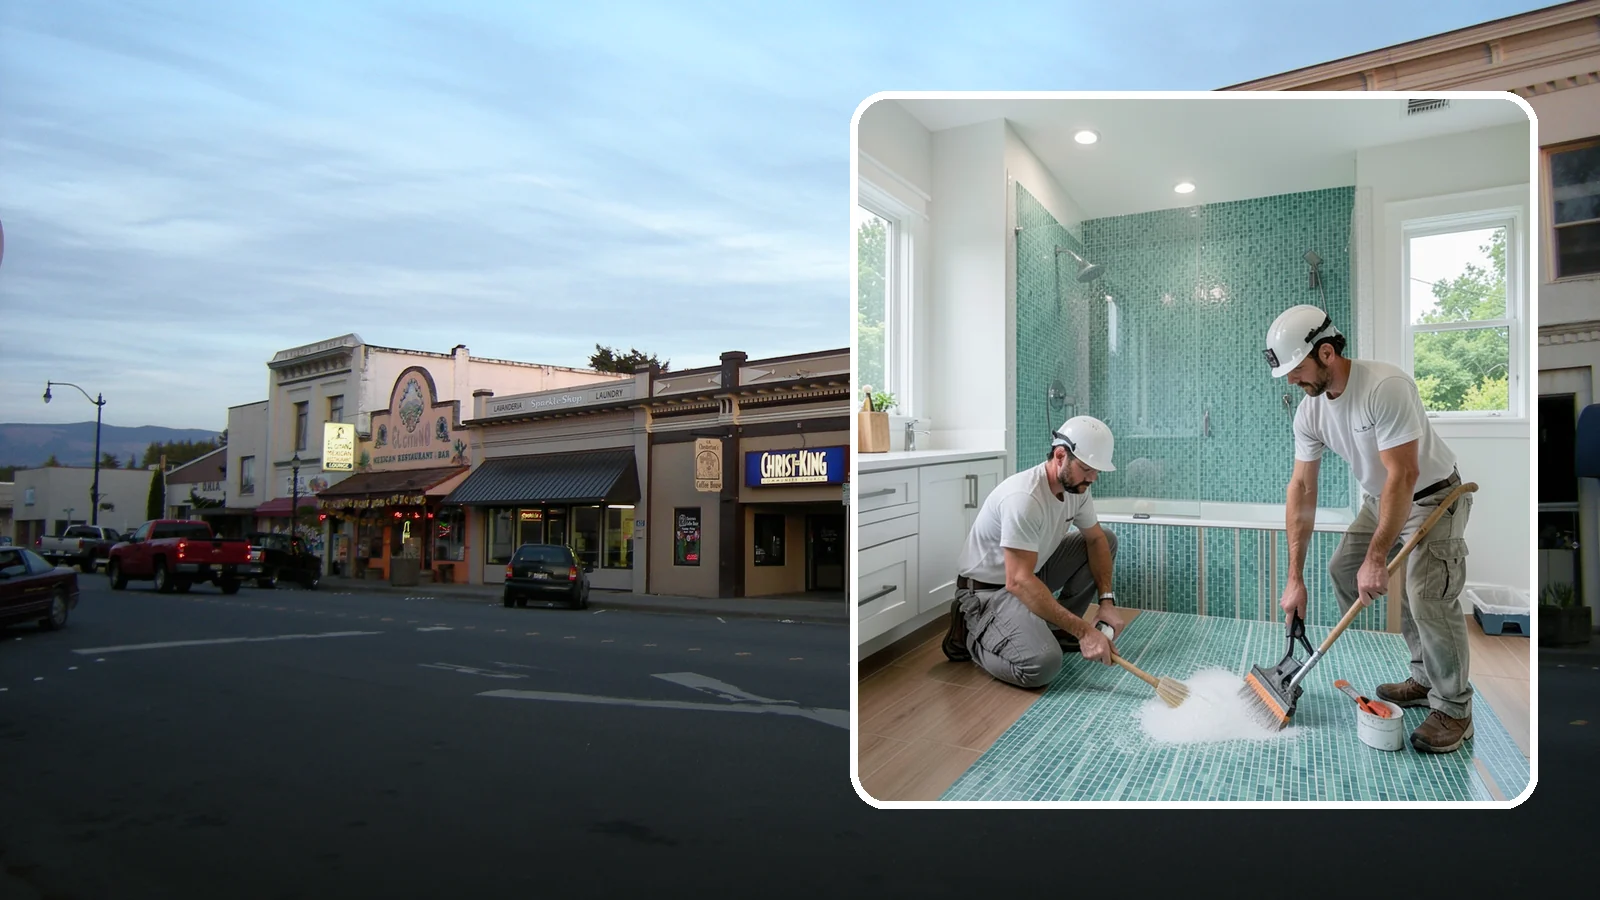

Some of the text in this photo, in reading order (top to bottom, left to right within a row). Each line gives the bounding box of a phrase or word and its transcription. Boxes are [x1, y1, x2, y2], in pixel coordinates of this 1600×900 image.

[531, 394, 582, 409] Sparkle Shop
[595, 389, 624, 400] LAUNDRY
[494, 402, 523, 412] LAVANDERIA
[373, 454, 396, 464] MEXICAN
[397, 451, 433, 462] RESTAURANT
[437, 450, 450, 459] BAR
[760, 452, 797, 478] CHRIST
[799, 449, 827, 477] KING
